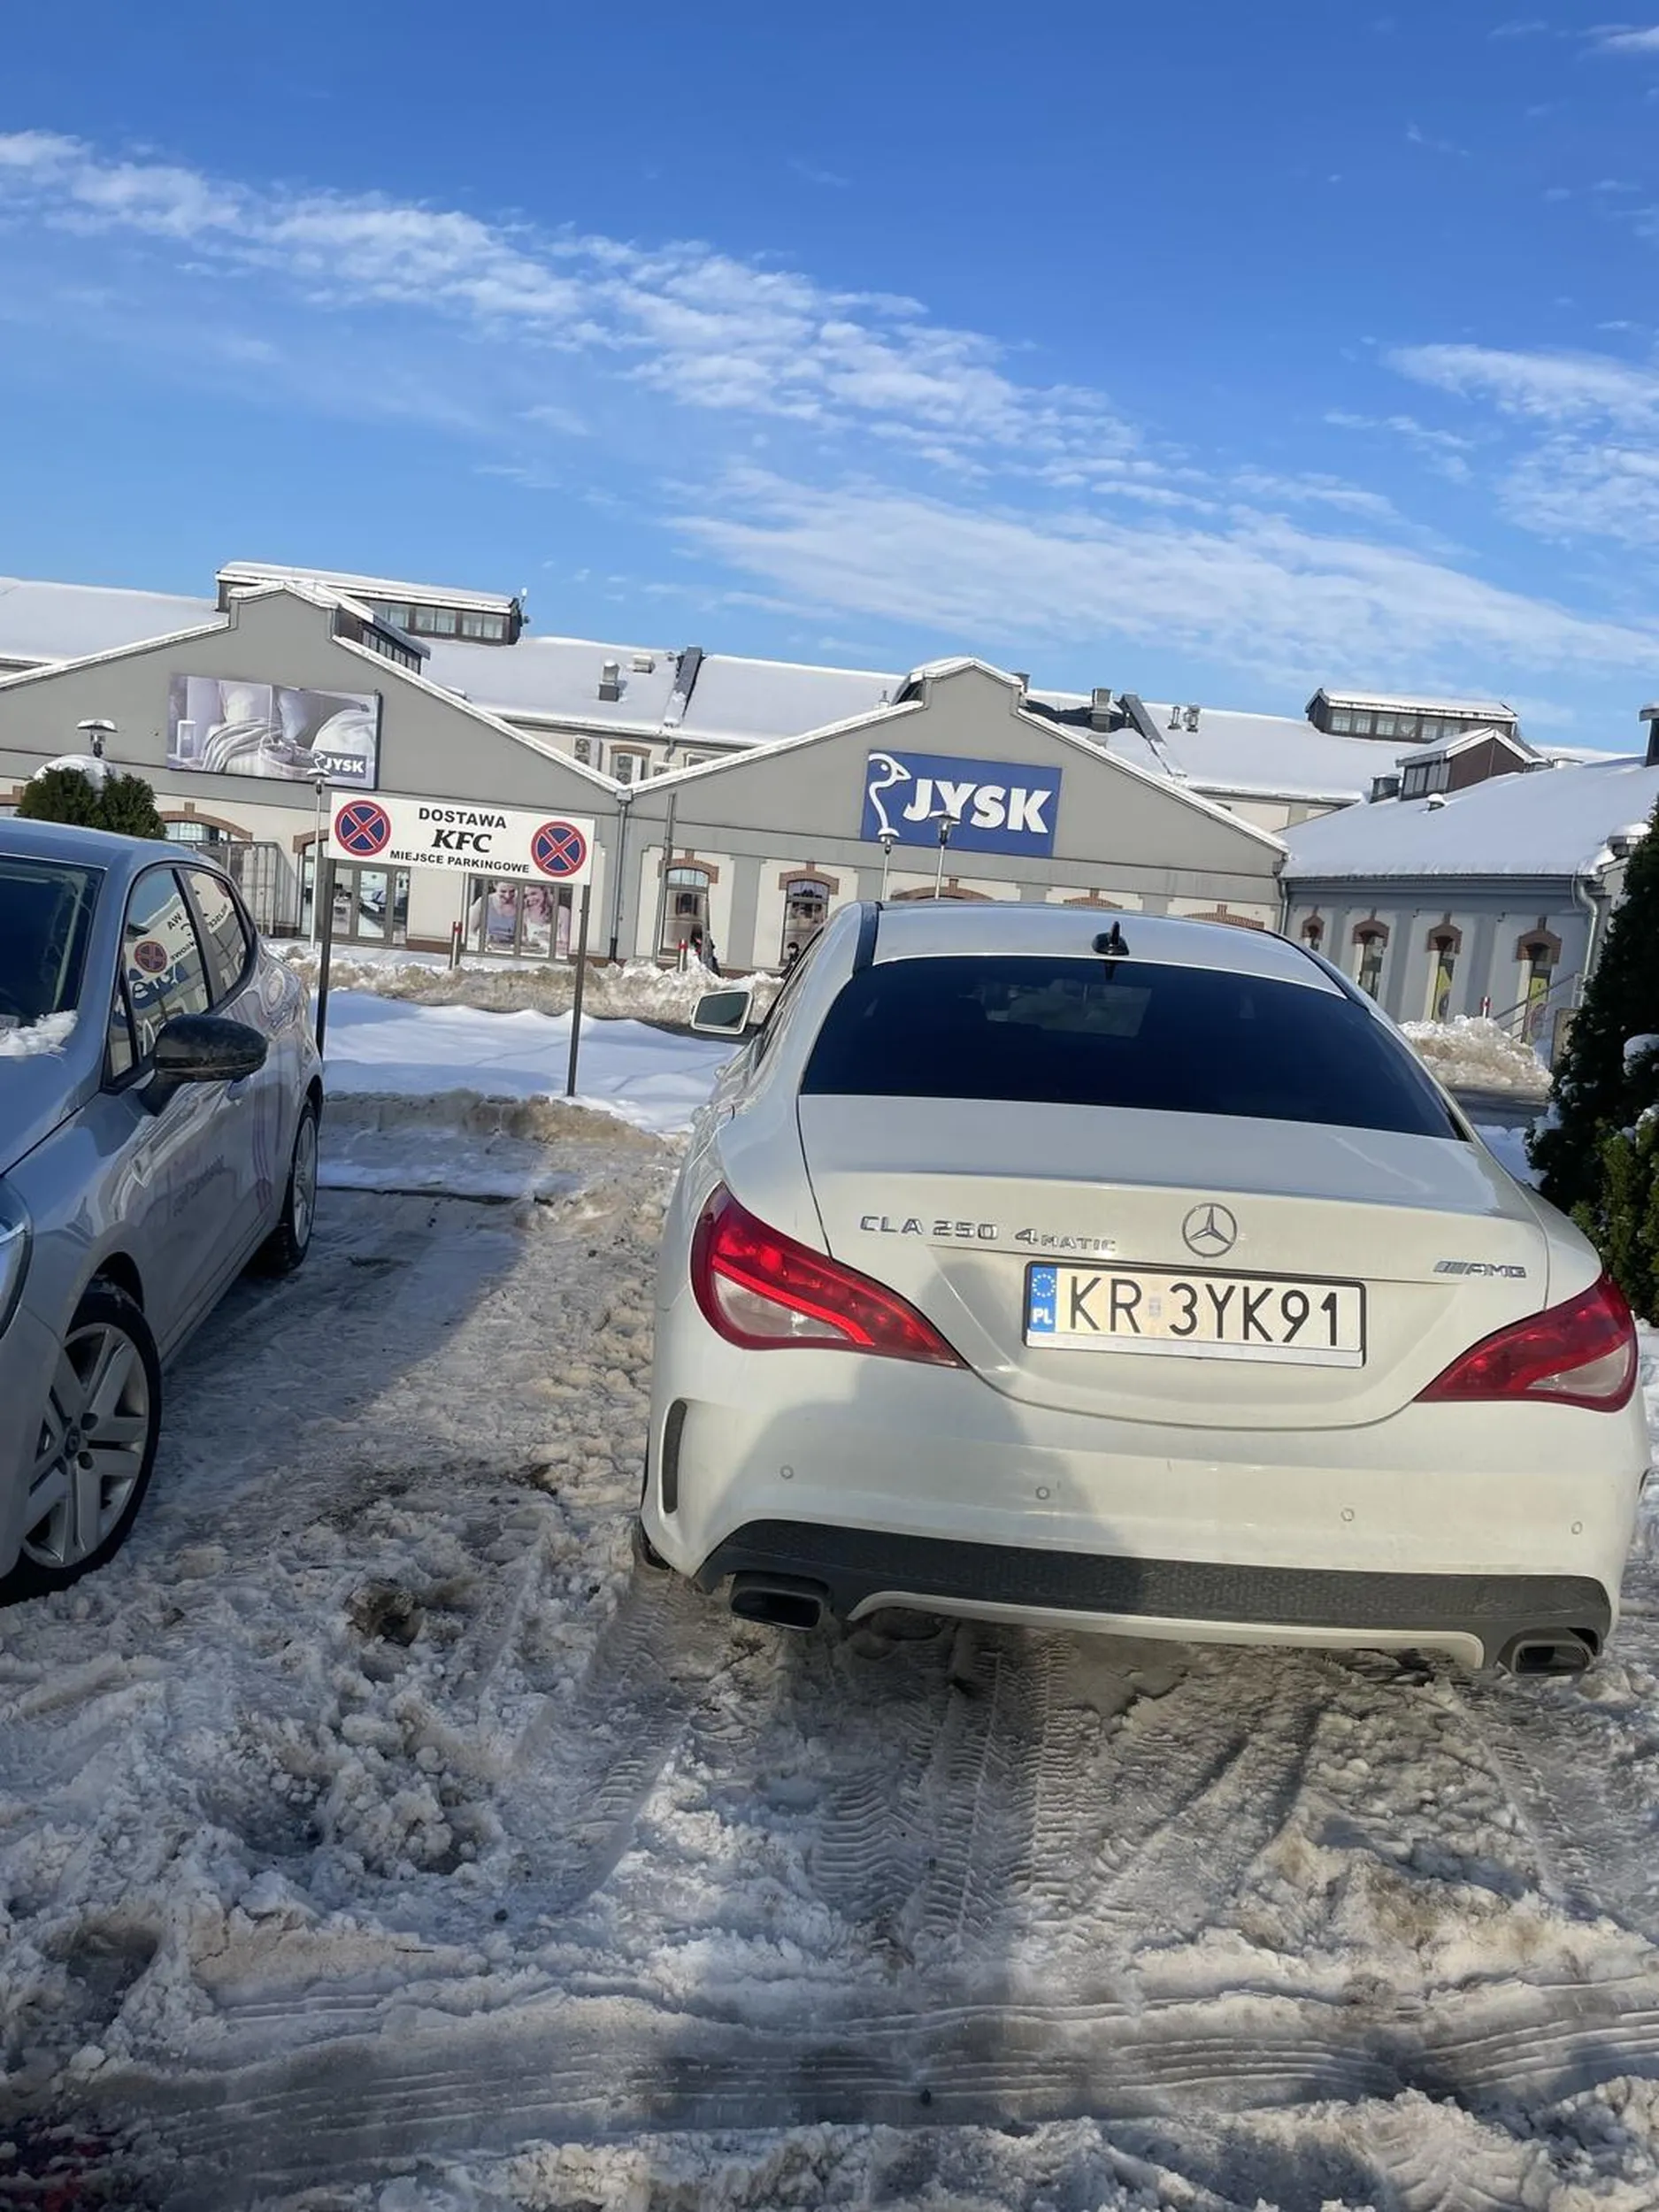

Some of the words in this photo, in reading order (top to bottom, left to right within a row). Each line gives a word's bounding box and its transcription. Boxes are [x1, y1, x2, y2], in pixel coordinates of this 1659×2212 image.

[324, 757, 365, 773] JYSK
[902, 778, 1053, 834] JYSK
[419, 807, 507, 829] DOSTAWA
[431, 828, 493, 853] KFC
[389, 850, 444, 864] MIEJSCE
[447, 856, 530, 873] PARKINGOWE
[861, 1216, 924, 1235] CLA
[933, 1220, 998, 1240] 250
[1033, 1308, 1053, 1325] PL
[1071, 1276, 1143, 1334] KR
[1168, 1282, 1339, 1347] 3YK91
